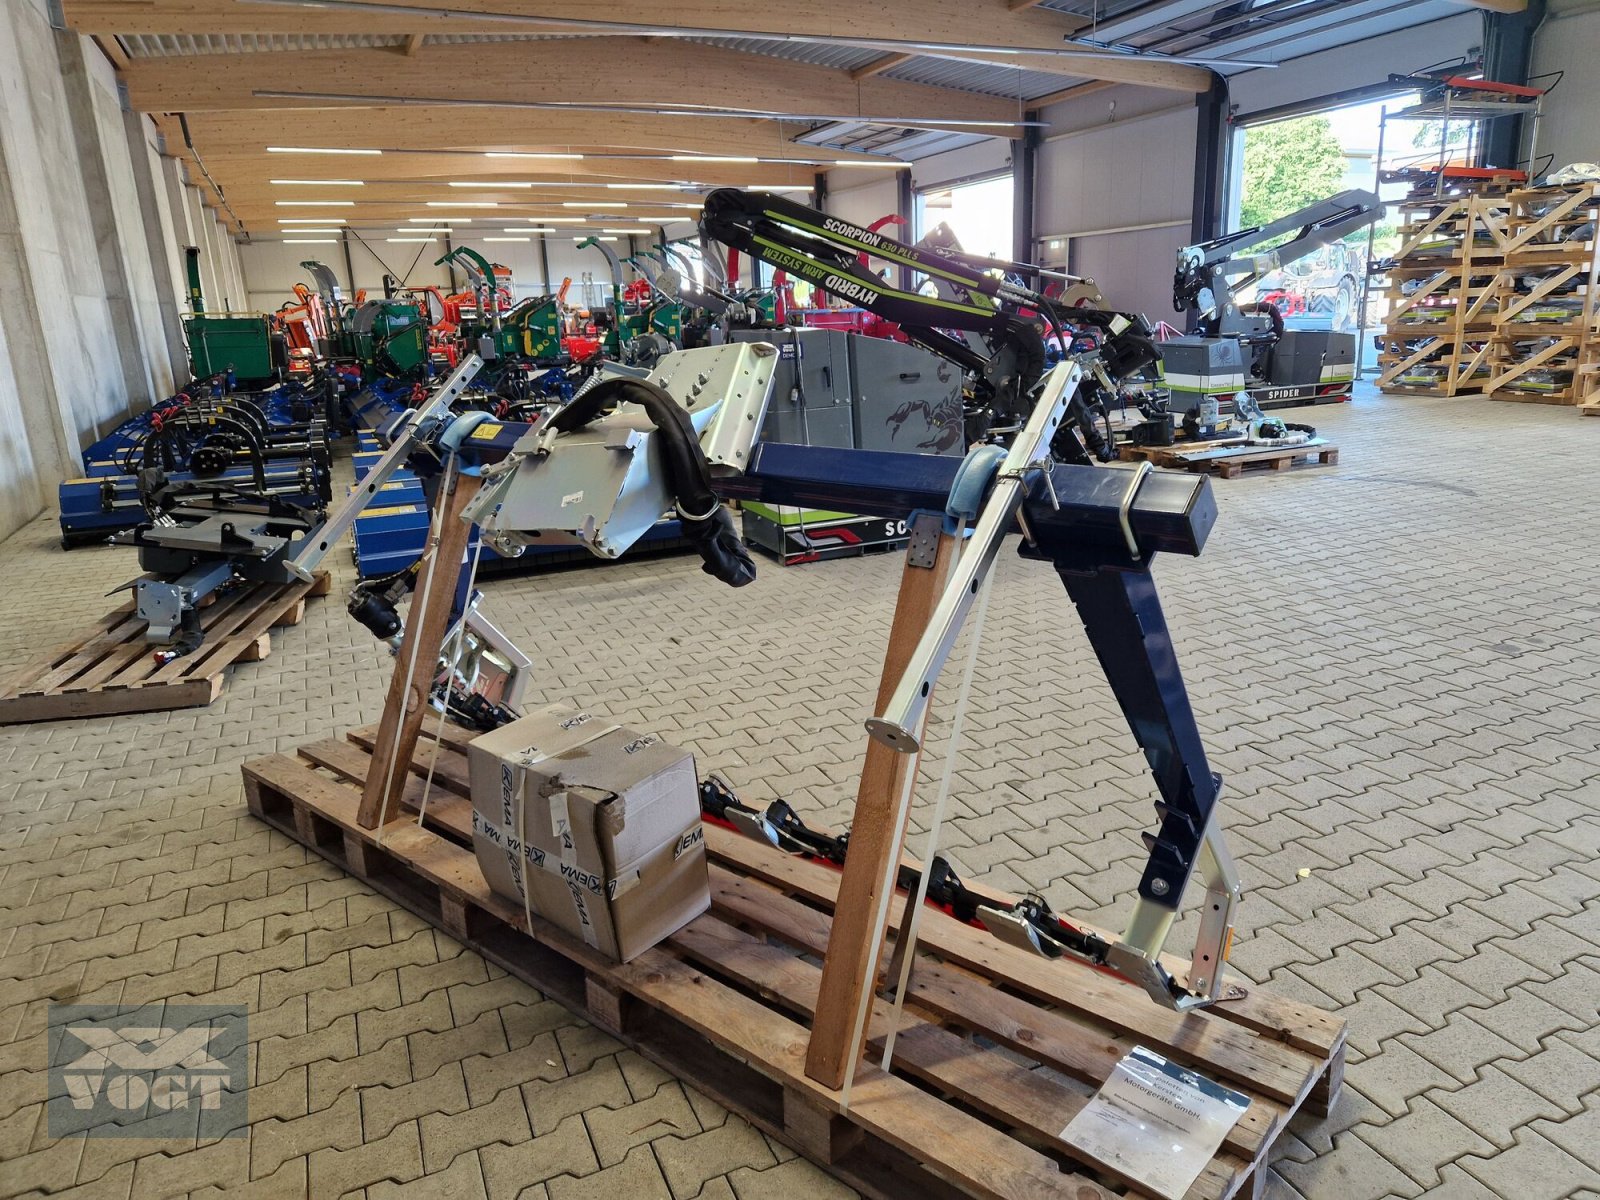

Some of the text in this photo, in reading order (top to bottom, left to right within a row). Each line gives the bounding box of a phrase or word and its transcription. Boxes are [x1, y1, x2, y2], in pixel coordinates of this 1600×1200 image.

[823, 219, 881, 246] SCORPION
[880, 242, 897, 253] 630
[762, 247, 878, 304] HYBRID ARM SYSTEM
[1268, 388, 1300, 399] SPIDER
[885, 520, 907, 537] SC
[502, 764, 513, 826] KEMA
[484, 822, 501, 843] MA
[1124, 1077, 1173, 1106] Motorgeräte
